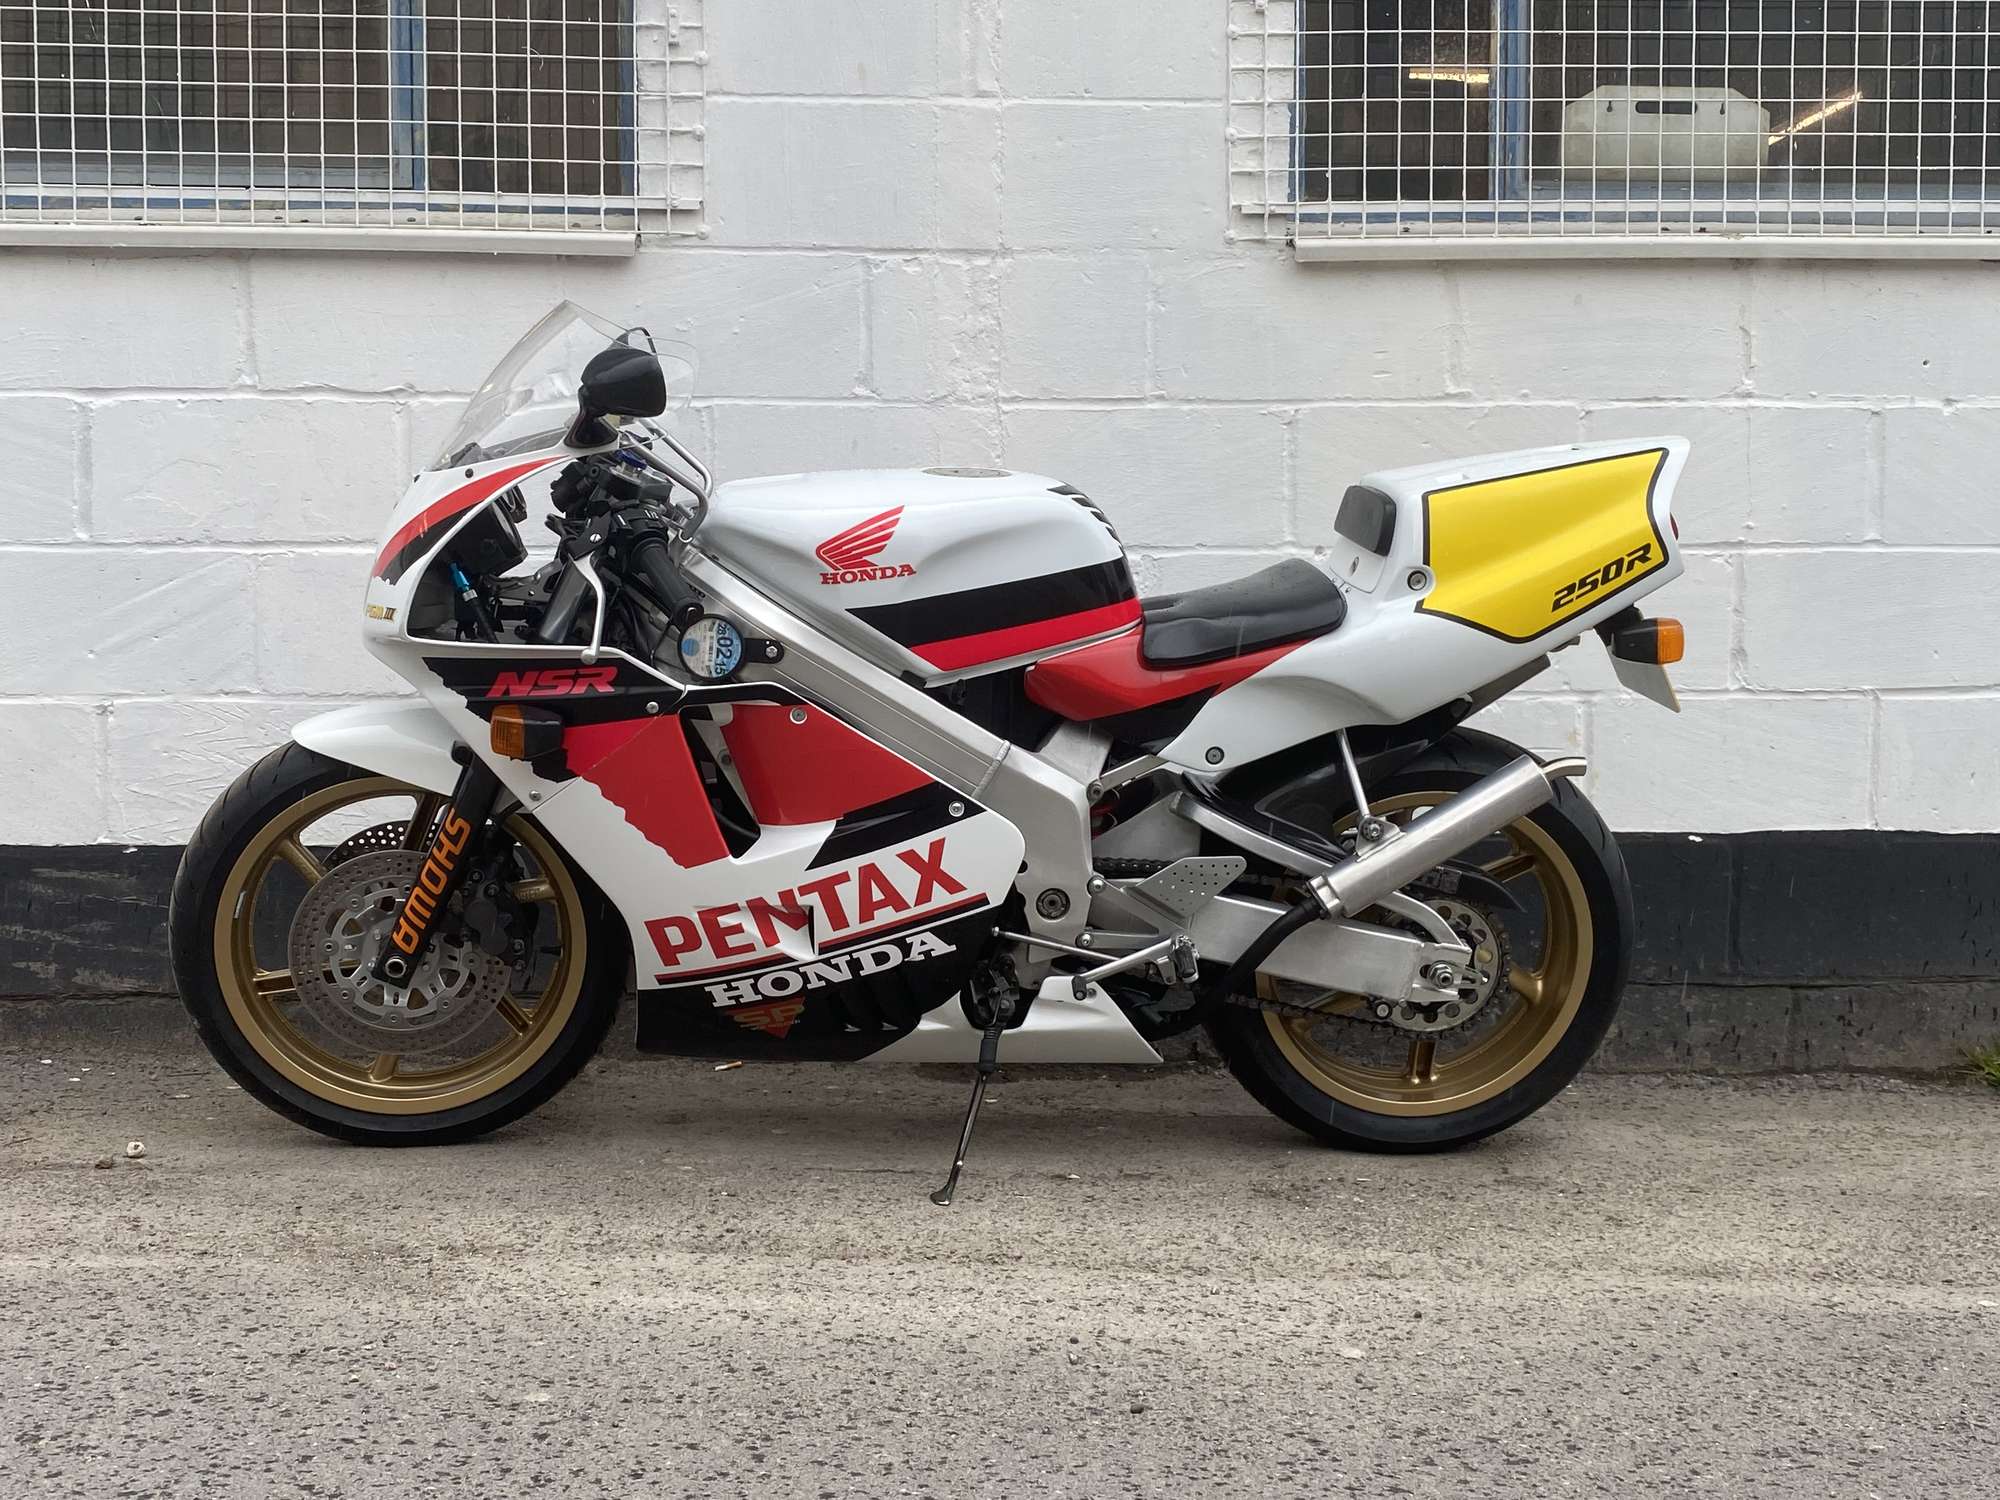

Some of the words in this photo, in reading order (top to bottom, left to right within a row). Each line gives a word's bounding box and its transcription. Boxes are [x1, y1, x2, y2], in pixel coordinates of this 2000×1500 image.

[820, 563, 917, 585] HONDA
[1551, 542, 1652, 613] 250R
[486, 666, 618, 699] NSR
[716, 637, 733, 659] 02
[393, 807, 471, 954] SHOWA
[643, 837, 967, 966] PENTAX
[704, 931, 957, 1008] HONDA
